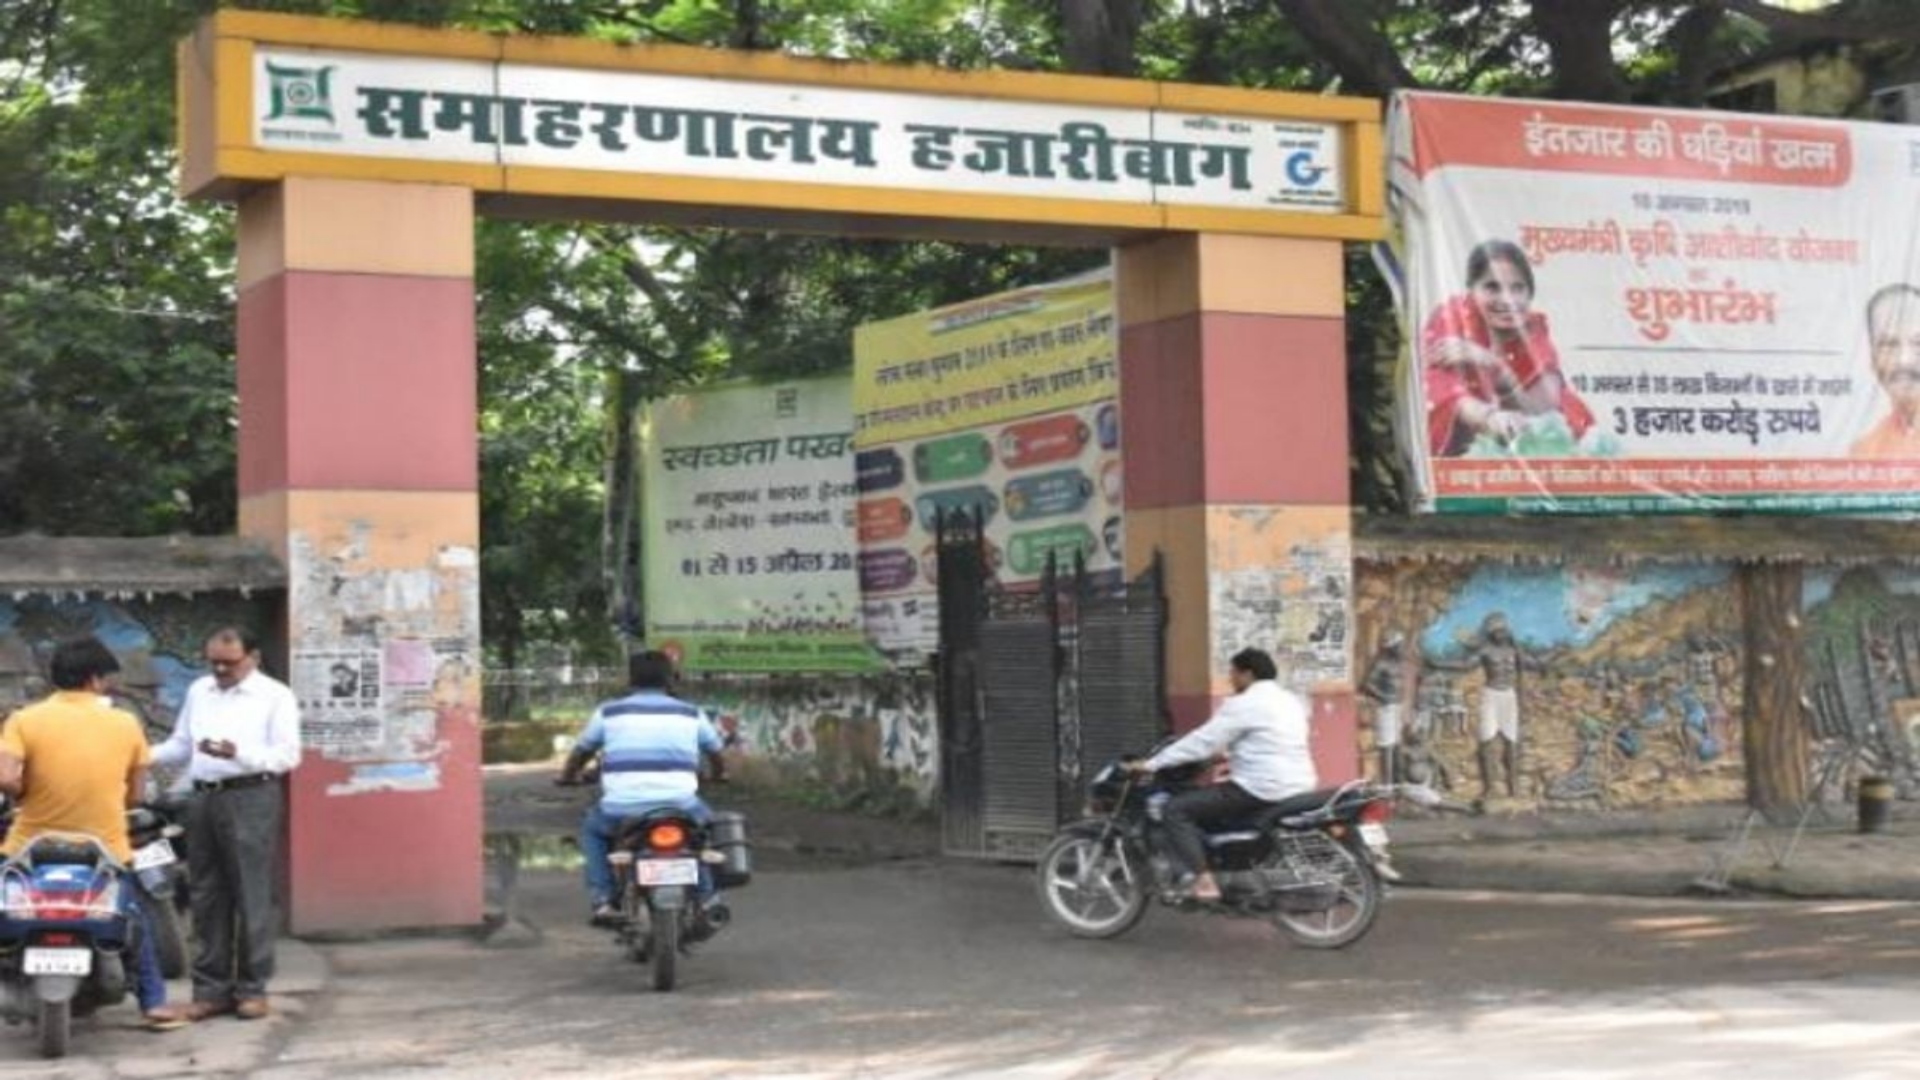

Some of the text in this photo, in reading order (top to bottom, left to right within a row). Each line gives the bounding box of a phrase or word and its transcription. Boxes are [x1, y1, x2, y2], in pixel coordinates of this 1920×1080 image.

[356, 84, 1254, 191] समाहरणालय हजारीबाग
[1523, 112, 1627, 157] इंतजार
[1631, 119, 1675, 160] की
[1768, 138, 1837, 170] खत्म
[1519, 219, 1621, 265] मुख्यमंत्री
[1626, 278, 1779, 341] शुभारंभ
[1612, 405, 1628, 435] 3
[1632, 406, 1696, 436] हजार
[1700, 399, 1761, 445] करोड़
[661, 437, 781, 471] स्वच्छता
[708, 551, 730, 576] से
[736, 555, 758, 576] 15
